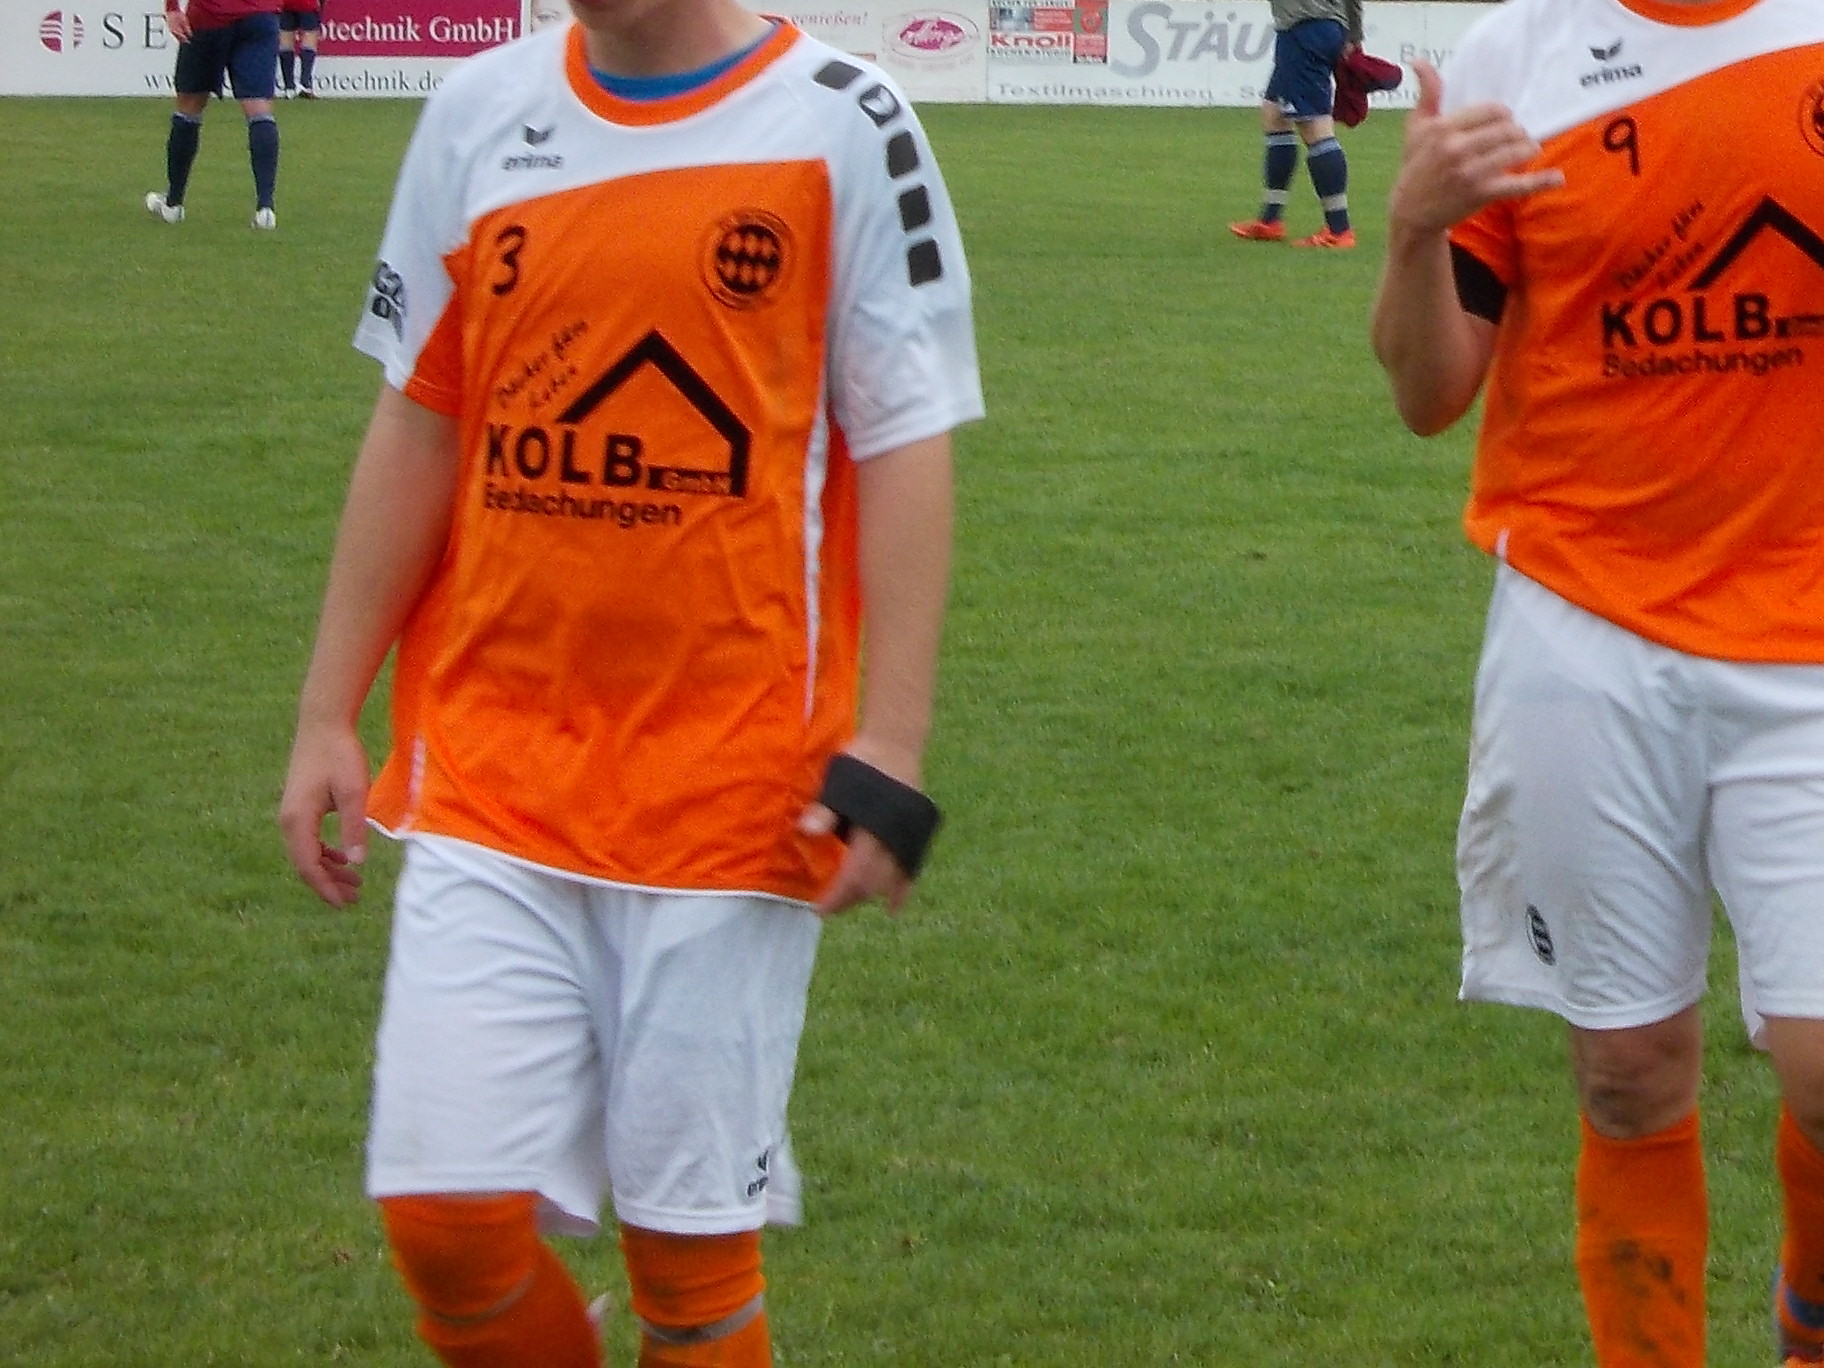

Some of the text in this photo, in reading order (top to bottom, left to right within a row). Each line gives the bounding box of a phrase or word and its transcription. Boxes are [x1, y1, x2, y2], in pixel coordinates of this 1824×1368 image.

[318, 15, 516, 43] otechnik GmbH
[990, 34, 1072, 48] Knoll
[1110, 1, 1275, 78] STÄU
[1603, 115, 1641, 177] 9
[492, 223, 527, 297] 3
[1601, 292, 1770, 349] KOLB
[486, 422, 643, 489] KOLB
